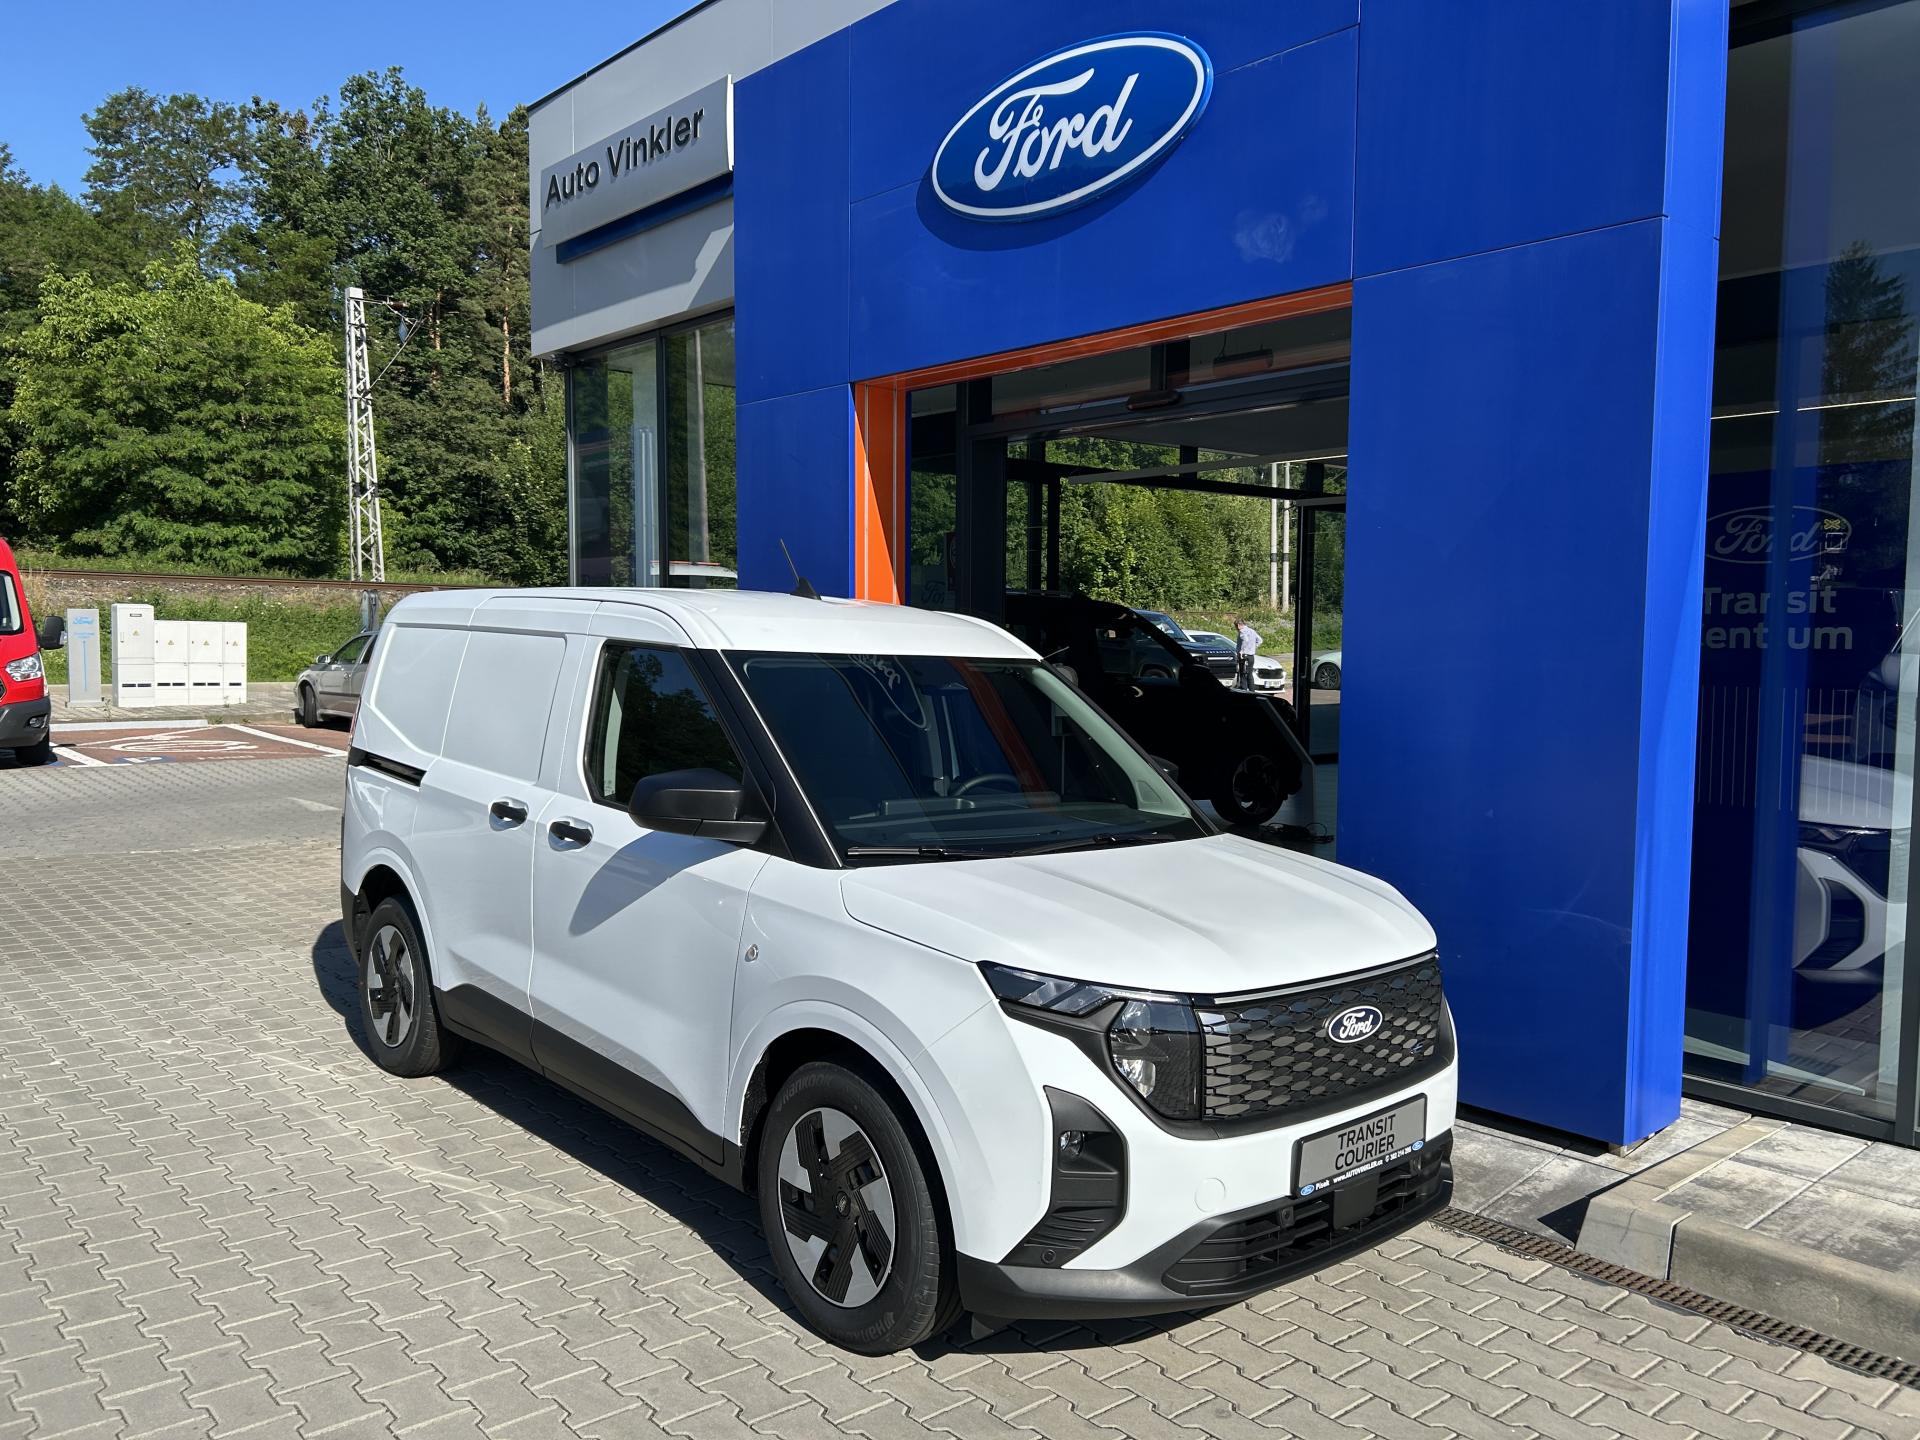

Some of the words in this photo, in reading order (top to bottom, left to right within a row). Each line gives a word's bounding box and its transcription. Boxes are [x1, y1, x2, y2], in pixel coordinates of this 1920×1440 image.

[973, 67, 1140, 192] Ford
[545, 161, 600, 209] Auto
[606, 107, 704, 178] Vinkler
[1701, 621, 1853, 651] entum
[1339, 1010, 1374, 1039] Ford
[1337, 1113, 1396, 1151] TRANSIT
[1334, 1133, 1395, 1171] COURIER
